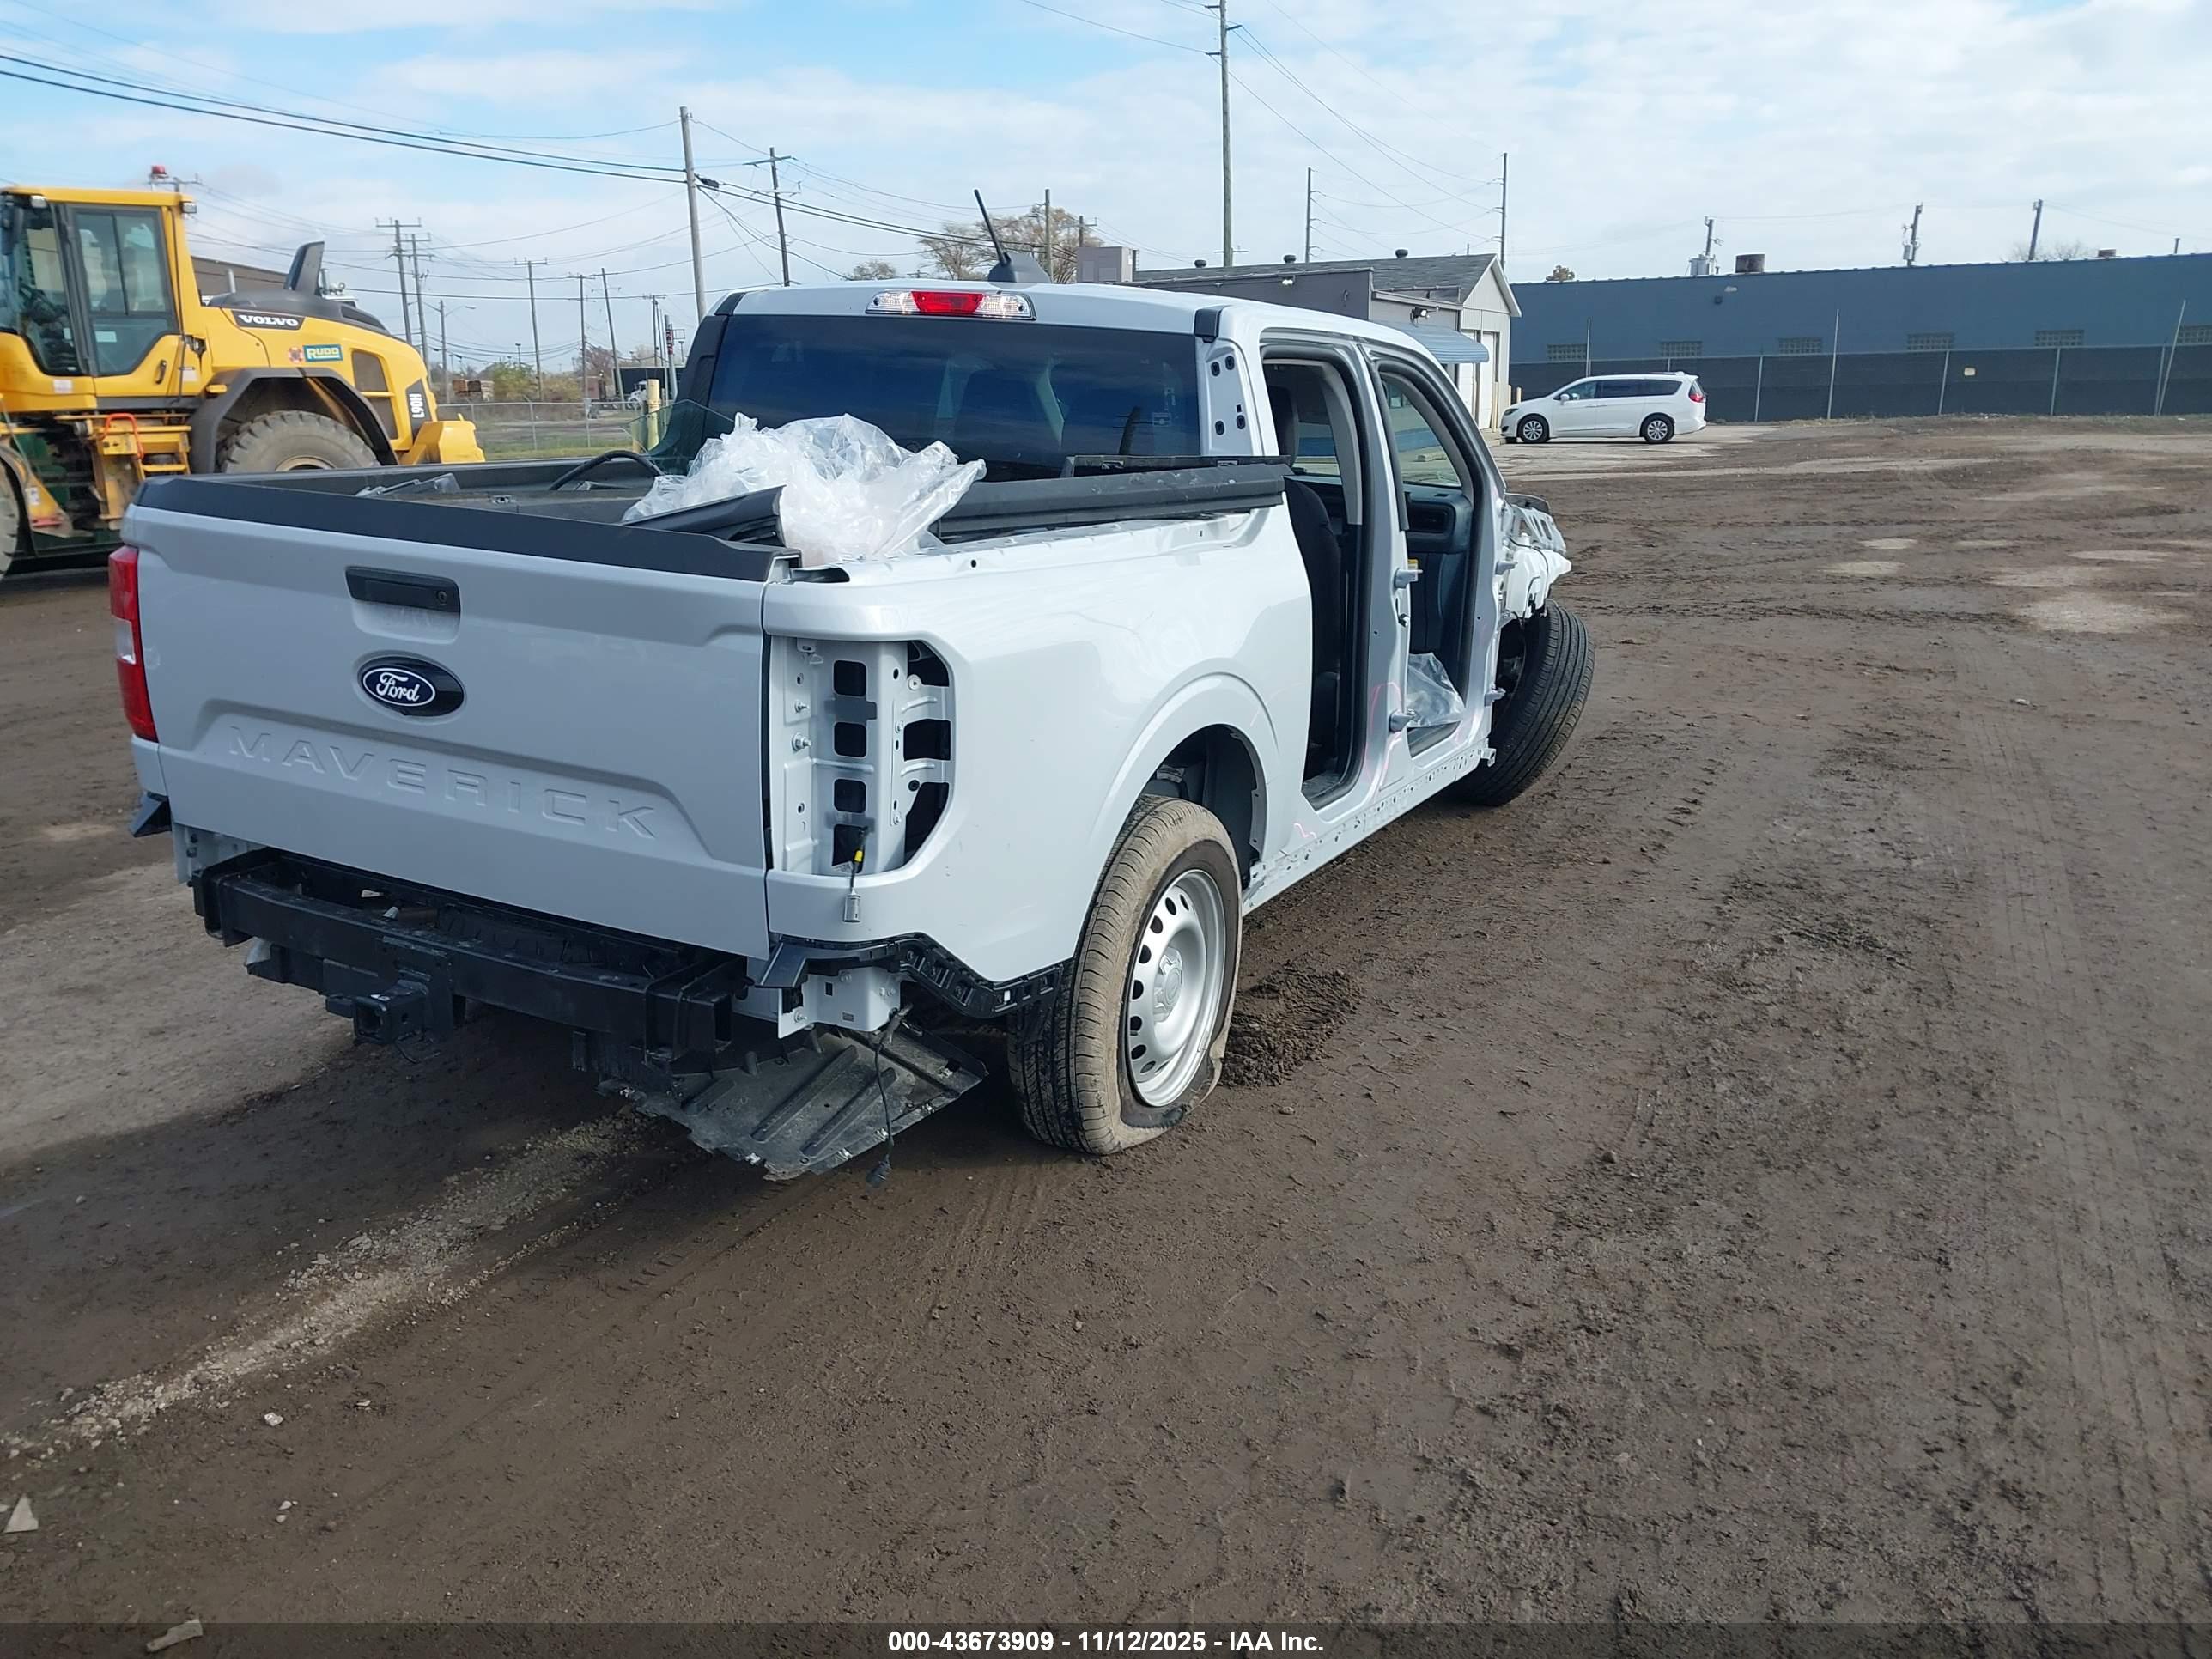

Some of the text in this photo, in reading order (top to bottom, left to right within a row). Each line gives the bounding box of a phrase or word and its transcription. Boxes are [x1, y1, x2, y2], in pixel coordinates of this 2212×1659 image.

[238, 314, 299, 326] VOLVO
[306, 347, 340, 360] RUDD
[409, 393, 425, 418] L90H
[376, 672, 420, 702] Ford
[228, 726, 657, 839] MAVERICK
